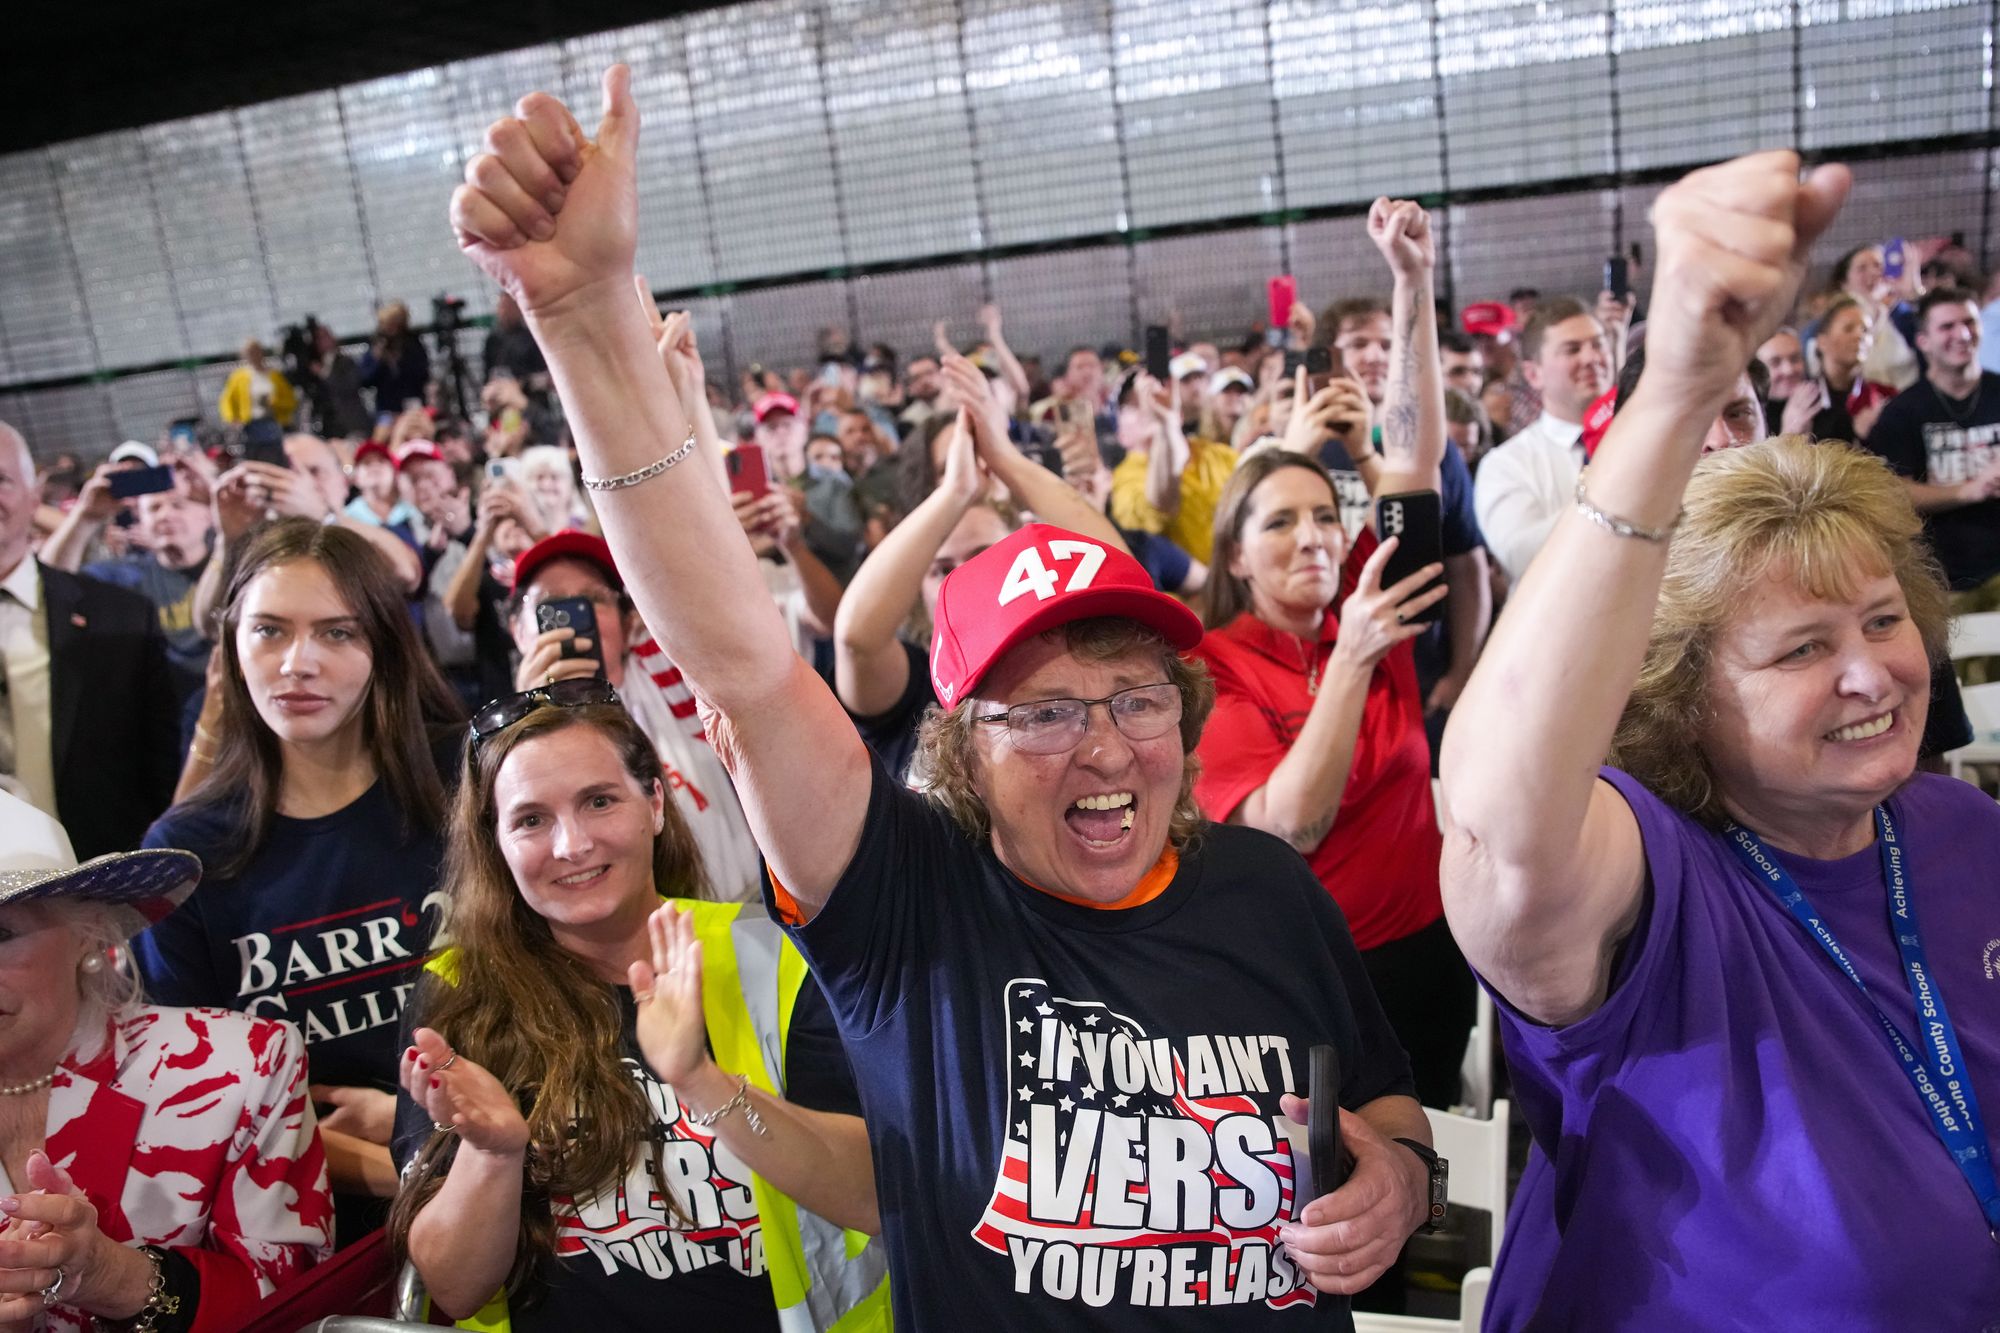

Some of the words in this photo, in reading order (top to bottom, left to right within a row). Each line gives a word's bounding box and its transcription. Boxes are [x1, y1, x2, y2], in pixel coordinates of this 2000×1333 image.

[998, 540, 1107, 607] 47
[1735, 831, 1781, 881] Schools
[1889, 847, 1908, 919] Achieving
[231, 915, 412, 997] BARR
[1911, 962, 1937, 1018] Schools
[1038, 1018, 1081, 1082] IF
[1078, 1031, 1175, 1097] YOU
[1187, 1034, 1296, 1098] AIN'T
[1929, 1021, 1955, 1076] County
[1913, 1064, 1960, 1132] Together
[1007, 1236, 1197, 1308] YOU'RE
[1208, 1244, 1307, 1305] LAS
